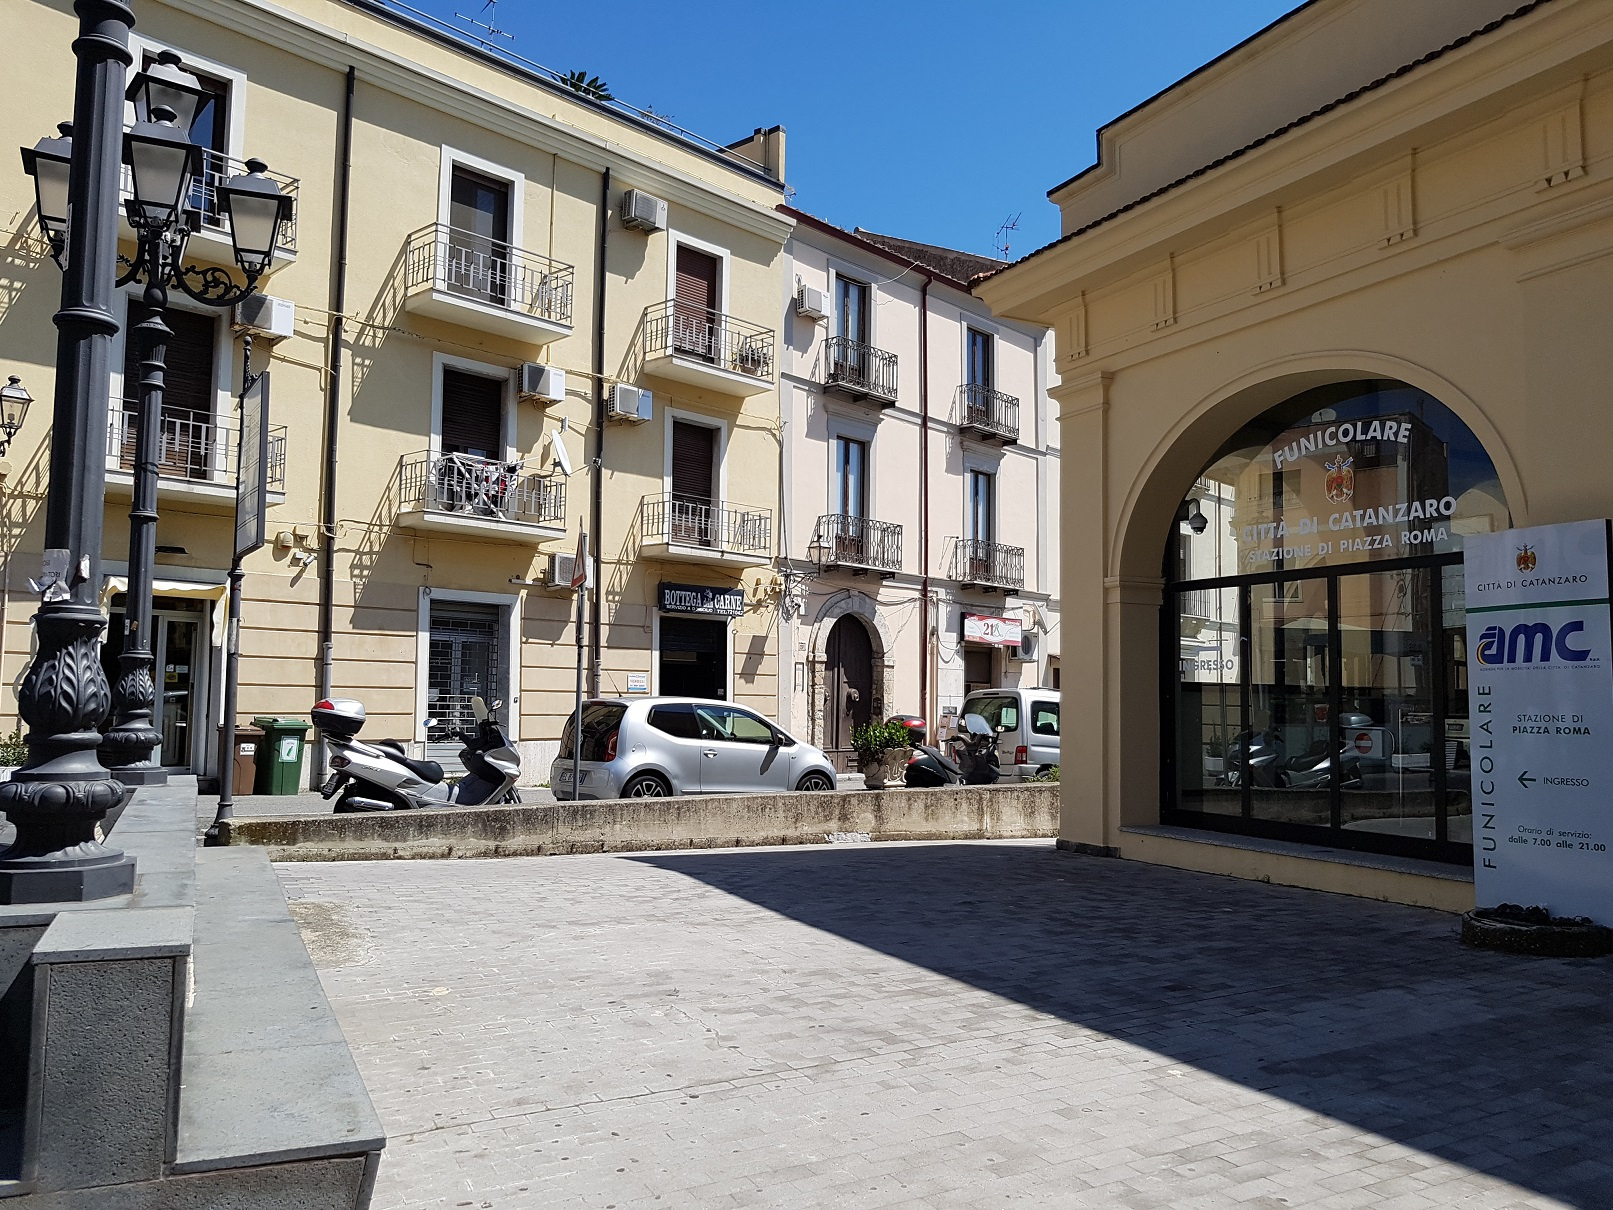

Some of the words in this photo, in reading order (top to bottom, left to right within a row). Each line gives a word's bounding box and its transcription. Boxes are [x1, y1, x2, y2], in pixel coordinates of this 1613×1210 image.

[1273, 420, 1412, 470] FUNICOLARE
[1243, 516, 1290, 543] CITTÀ
[1300, 517, 1318, 534] DI
[1328, 496, 1457, 531] CATANZARO
[1249, 546, 1311, 563] STAZIONE
[1319, 542, 1332, 555] DI
[1340, 535, 1393, 552] PIAZZA
[1401, 527, 1448, 544] ROMA
[1477, 582, 1502, 592] CITTÀ
[1506, 581, 1516, 589] DI
[1521, 574, 1588, 588] CATANZARO
[664, 590, 702, 606] BOTTEGA
[714, 594, 742, 610] CARNE
[1476, 620, 1592, 665] amc
[1178, 659, 1234, 671] INGRESSO
[1516, 714, 1566, 723] STAZIONE
[1572, 714, 1582, 723] DI
[1512, 726, 1550, 735] PIAZZA
[1556, 726, 1591, 736] ROMA
[1478, 685, 1497, 869] FUNICOLARE
[1543, 776, 1590, 787] INGRESSO
[1518, 825, 1542, 835] Orario
[1546, 828, 1554, 836] di
[1558, 830, 1592, 840] servizio:
[1508, 835, 1528, 845] dalle
[1532, 838, 1552, 847] 7.00
[1556, 839, 1574, 849] alle
[1578, 842, 1606, 852] 21.00
